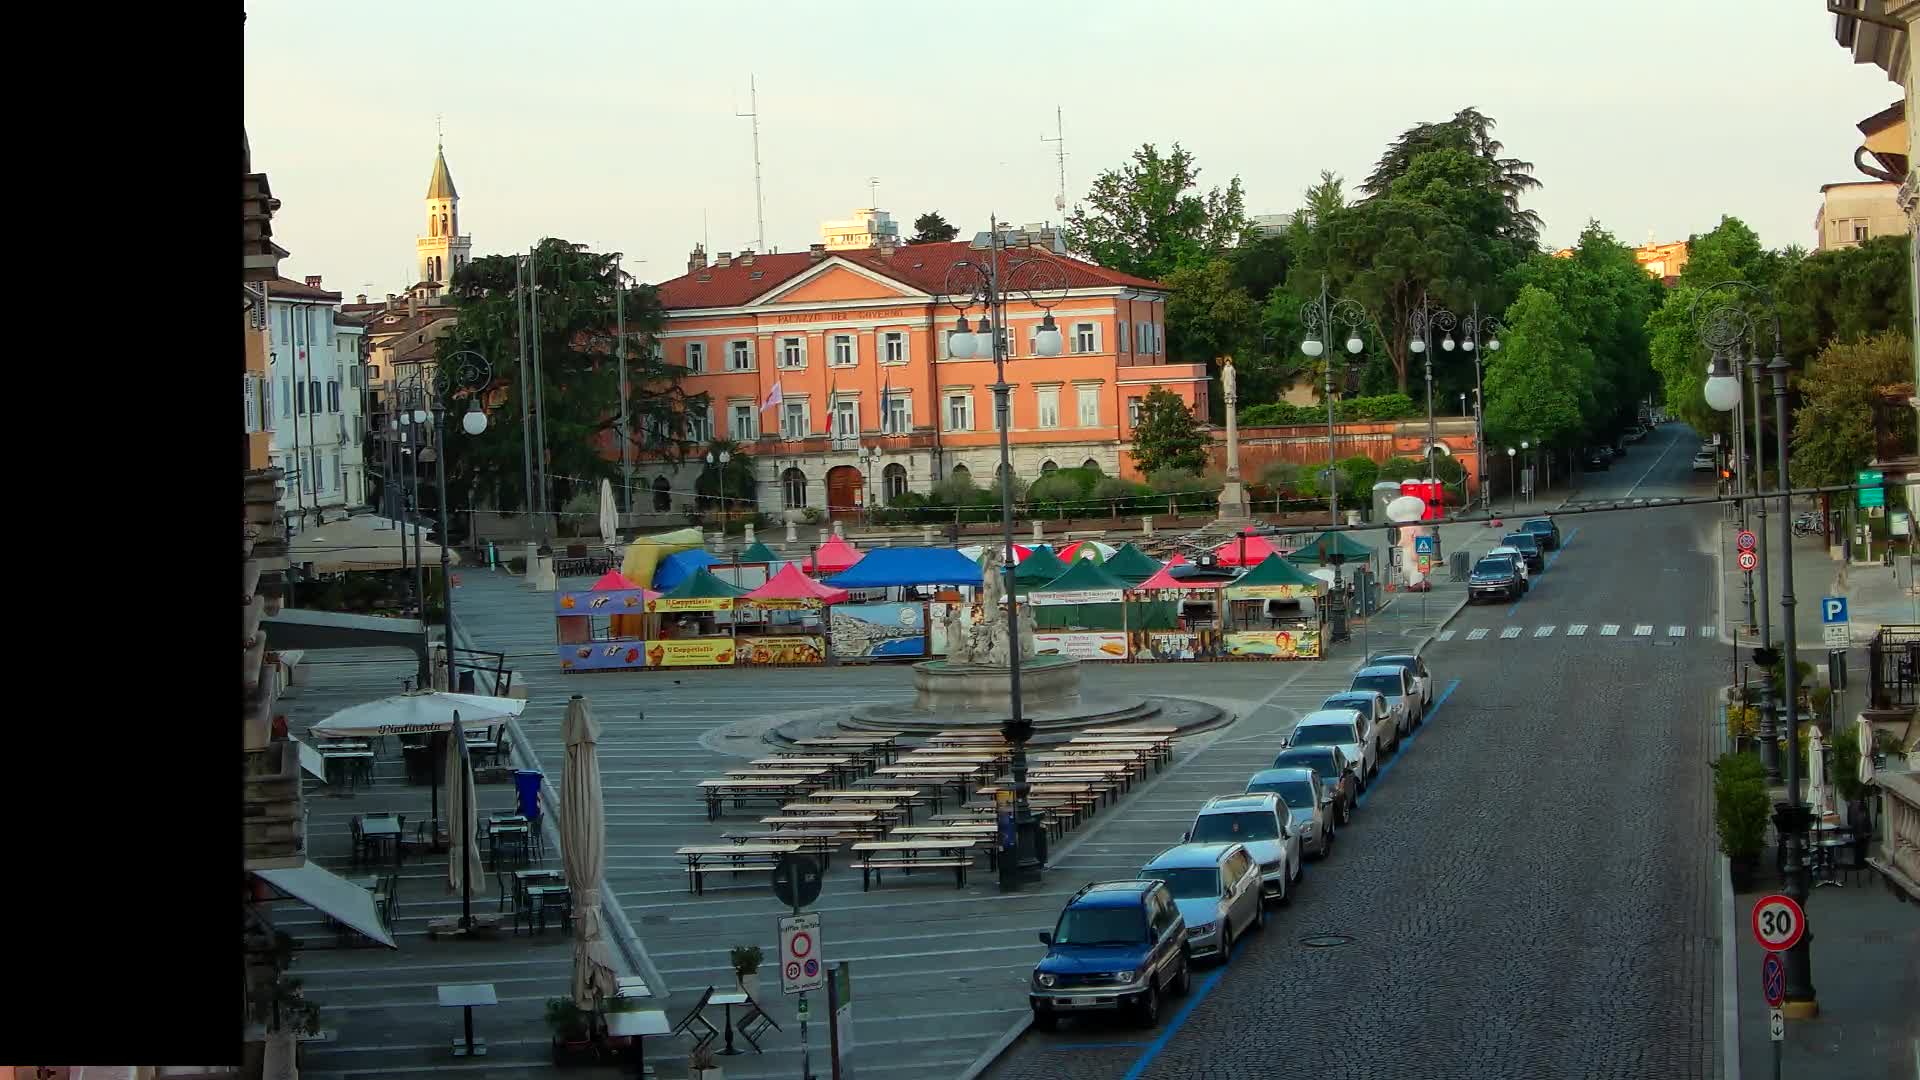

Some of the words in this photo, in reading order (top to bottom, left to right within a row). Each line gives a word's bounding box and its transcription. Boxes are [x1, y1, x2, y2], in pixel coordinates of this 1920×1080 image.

[1742, 555, 1753, 565] 20
[1827, 600, 1843, 621] P
[378, 723, 441, 734] Piadineria
[1762, 909, 1792, 936] 30
